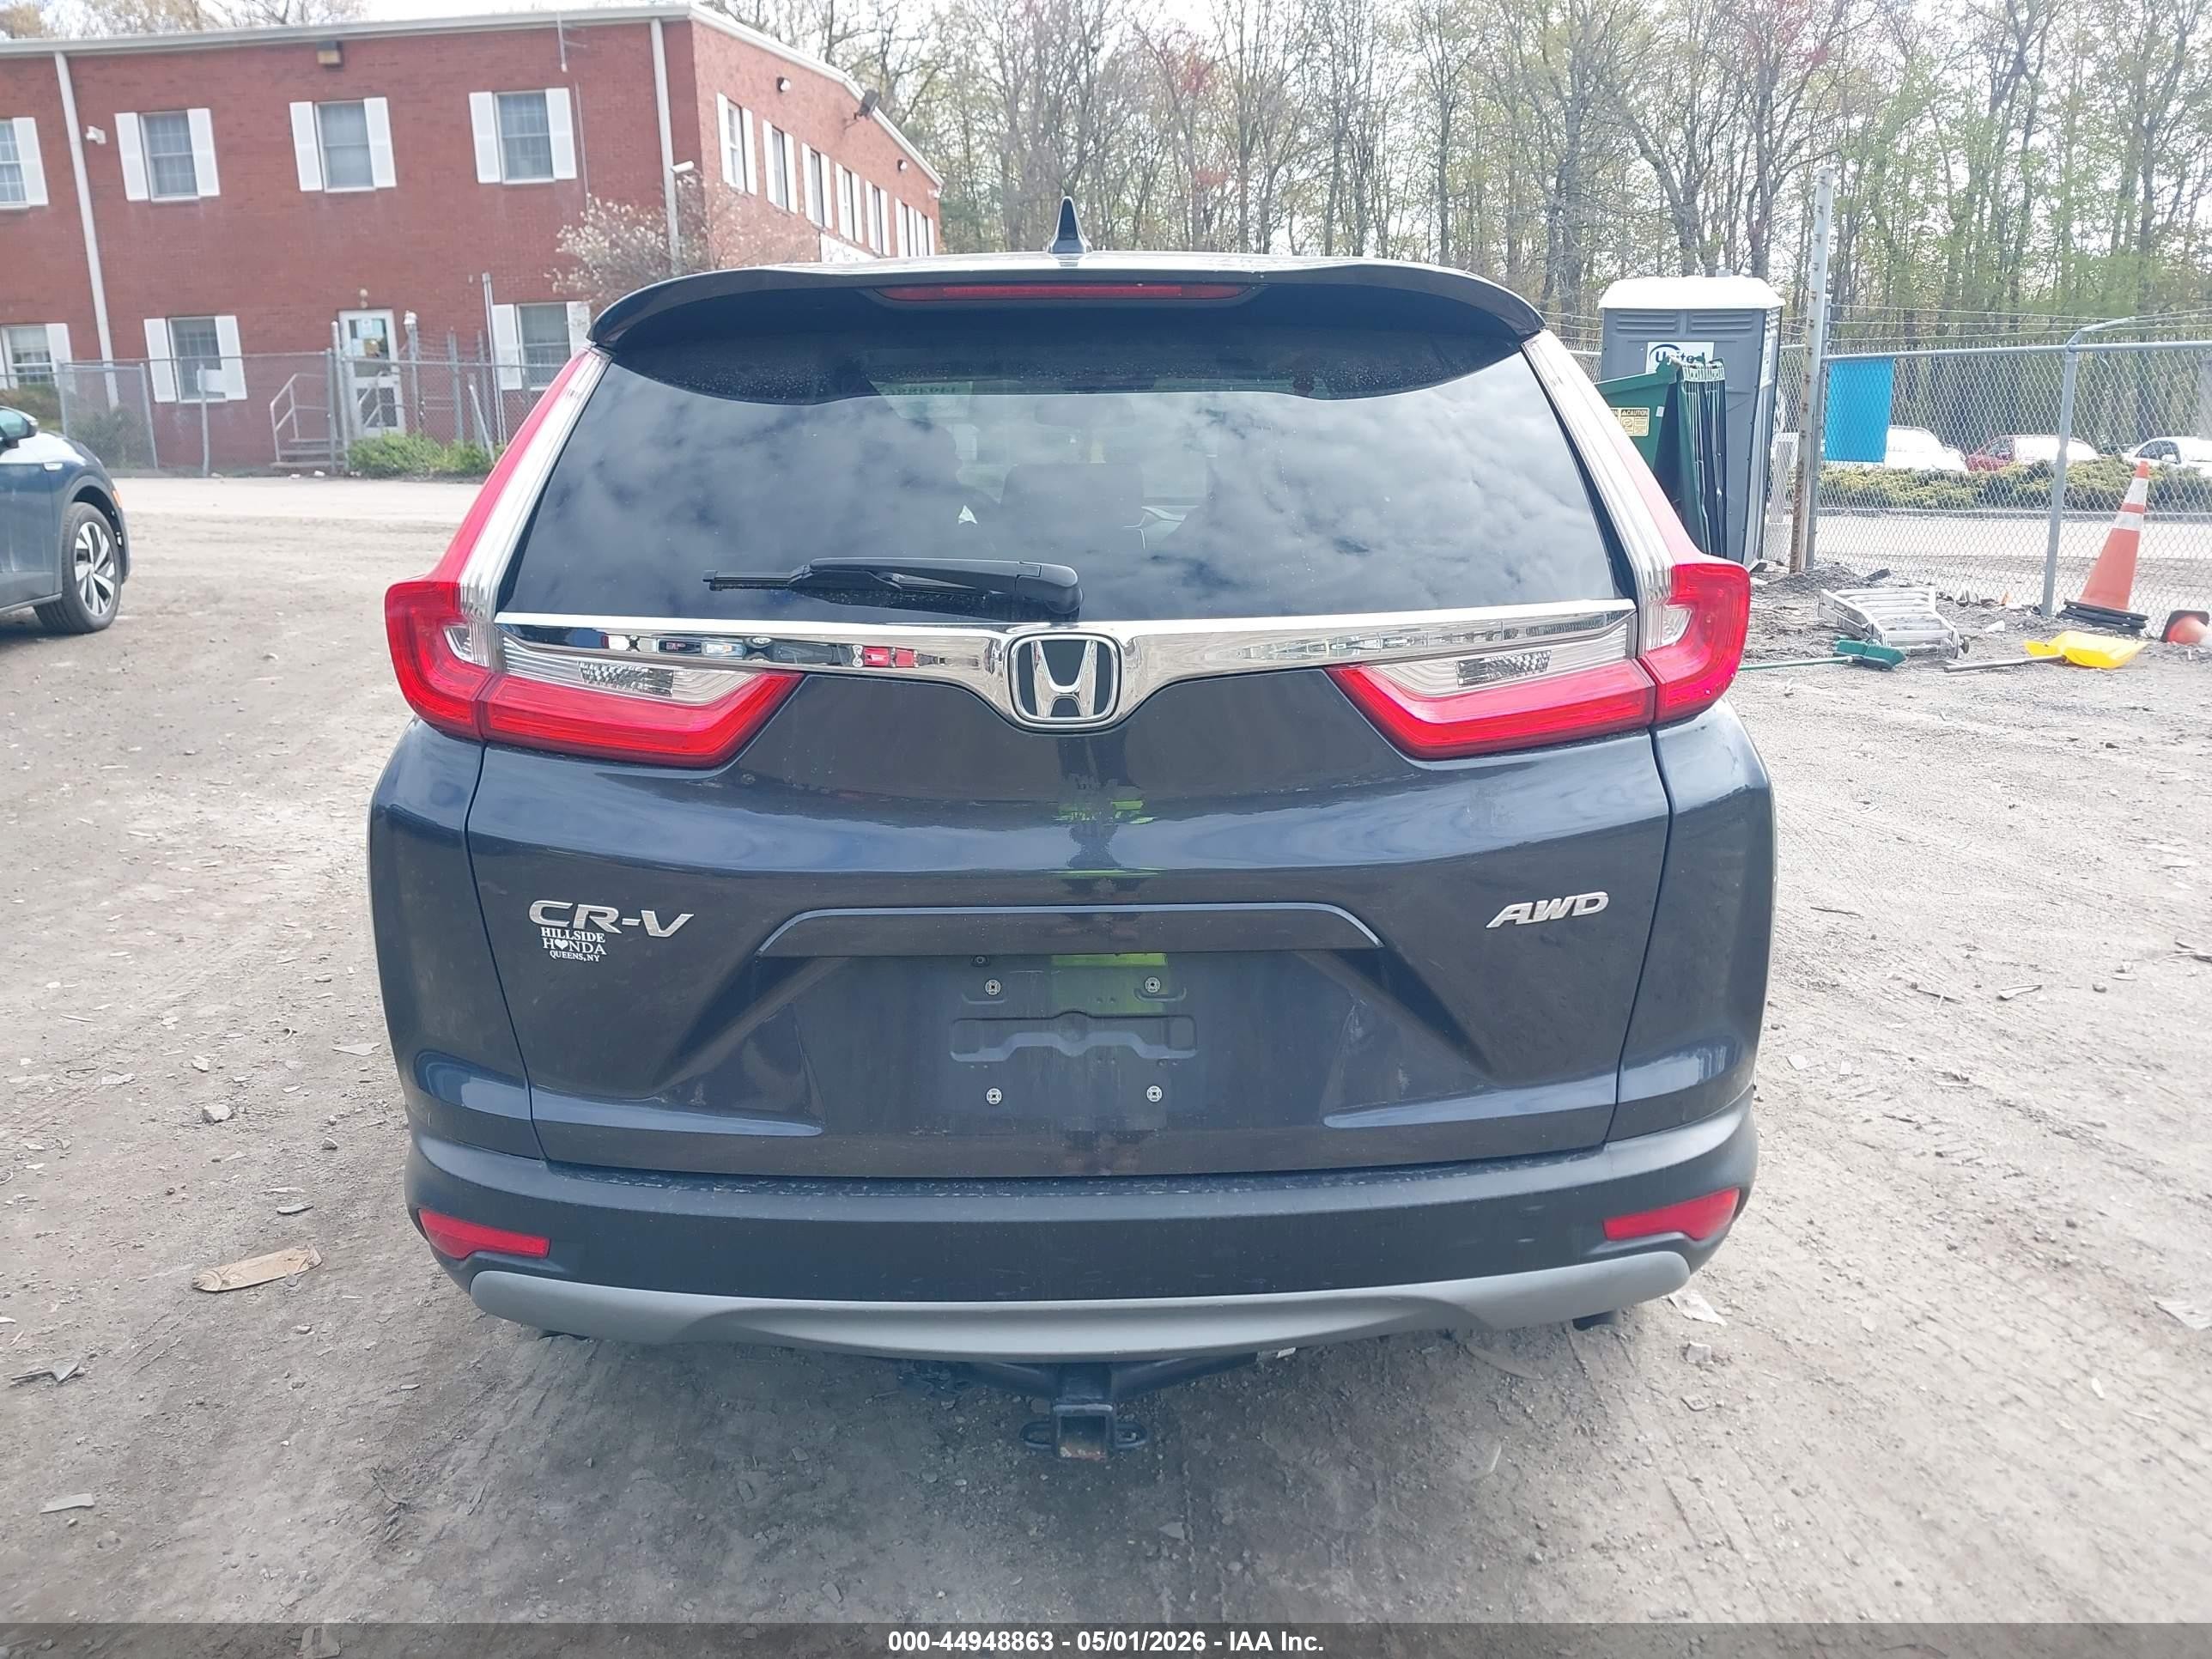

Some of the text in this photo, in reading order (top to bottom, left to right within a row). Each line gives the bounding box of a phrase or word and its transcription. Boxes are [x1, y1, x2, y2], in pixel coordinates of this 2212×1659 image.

[1656, 351, 1705, 364] Uite
[529, 900, 694, 938] CR-V
[1486, 891, 1609, 928] AWD
[540, 927, 605, 943] HILLSIDE
